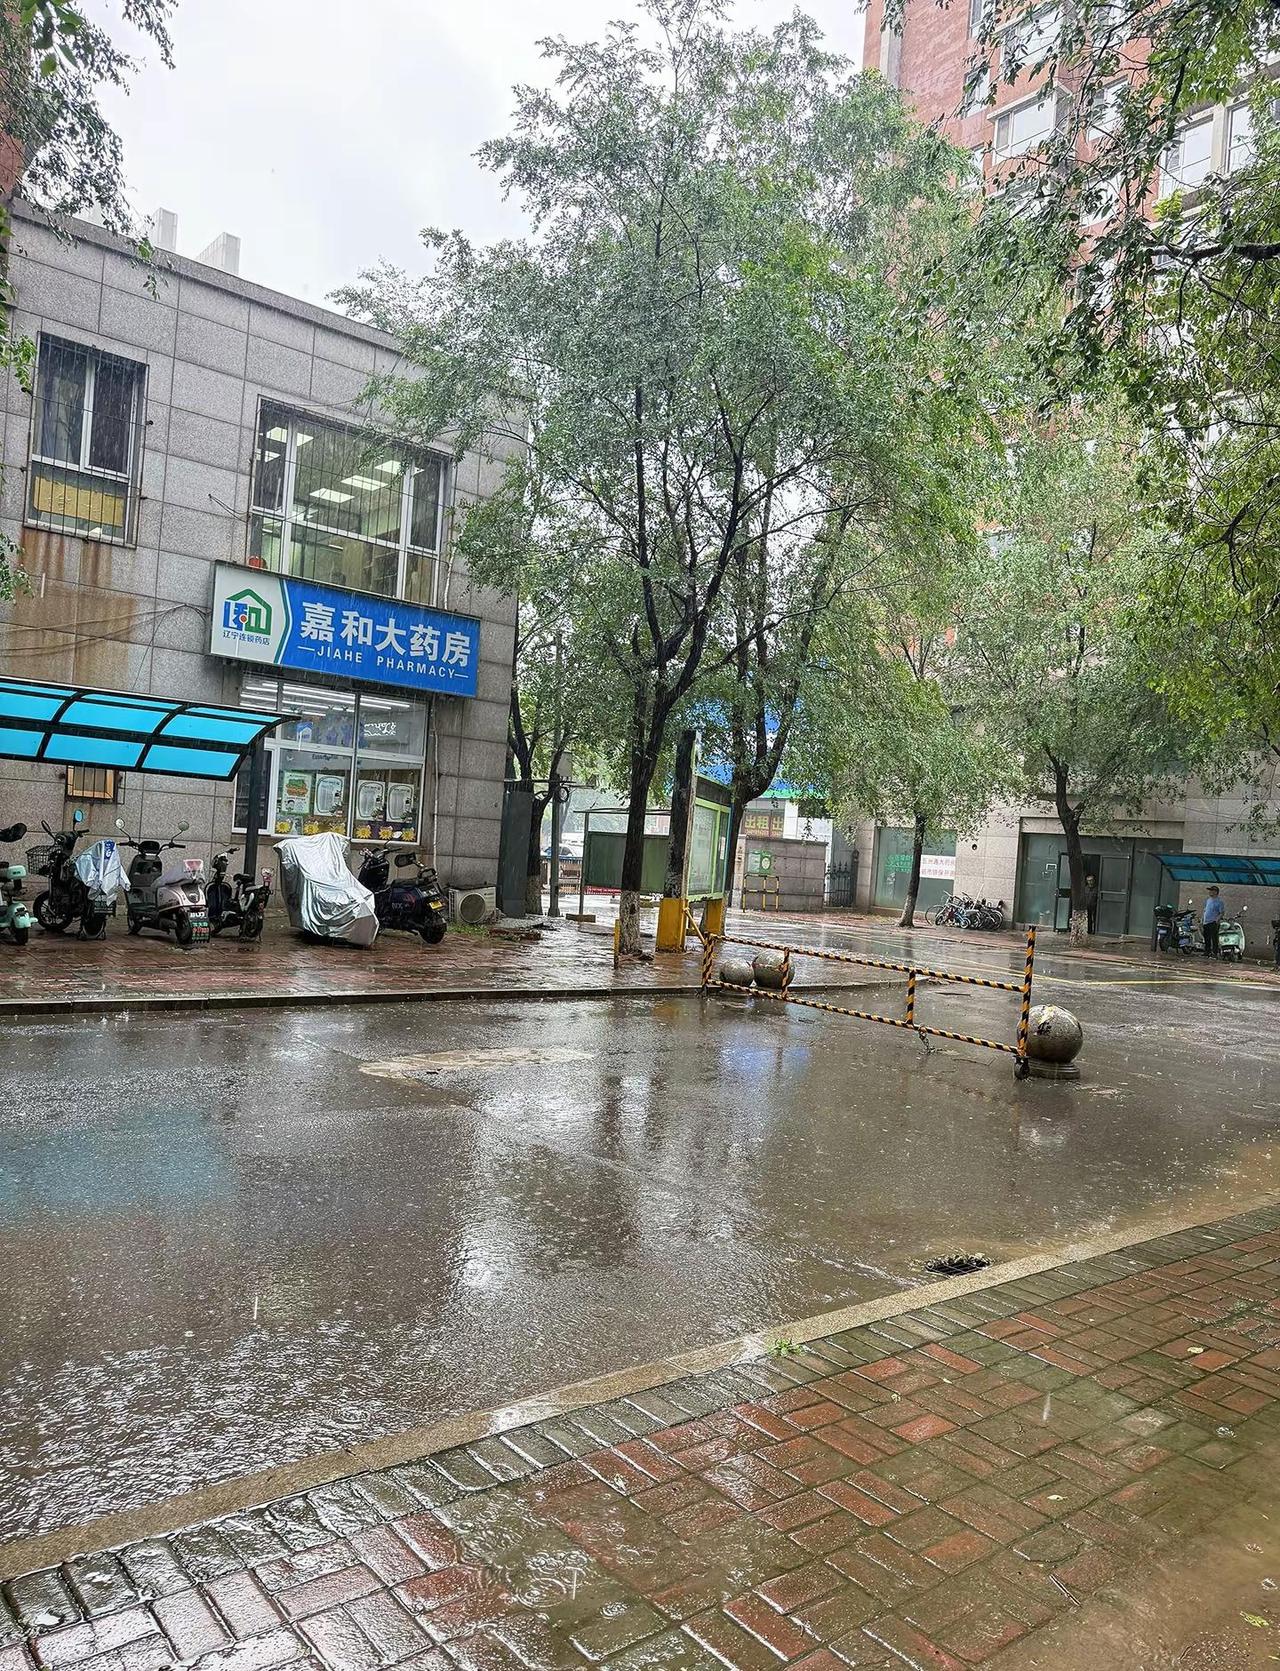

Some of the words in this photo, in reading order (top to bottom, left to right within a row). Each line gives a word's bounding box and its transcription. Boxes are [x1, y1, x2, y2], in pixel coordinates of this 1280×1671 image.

[222, 630, 271, 646] 辽宁连锁药店
[300, 601, 471, 667] 嘉和大药房
[317, 645, 363, 664] JIAHE
[376, 655, 456, 679] PHARMACY
